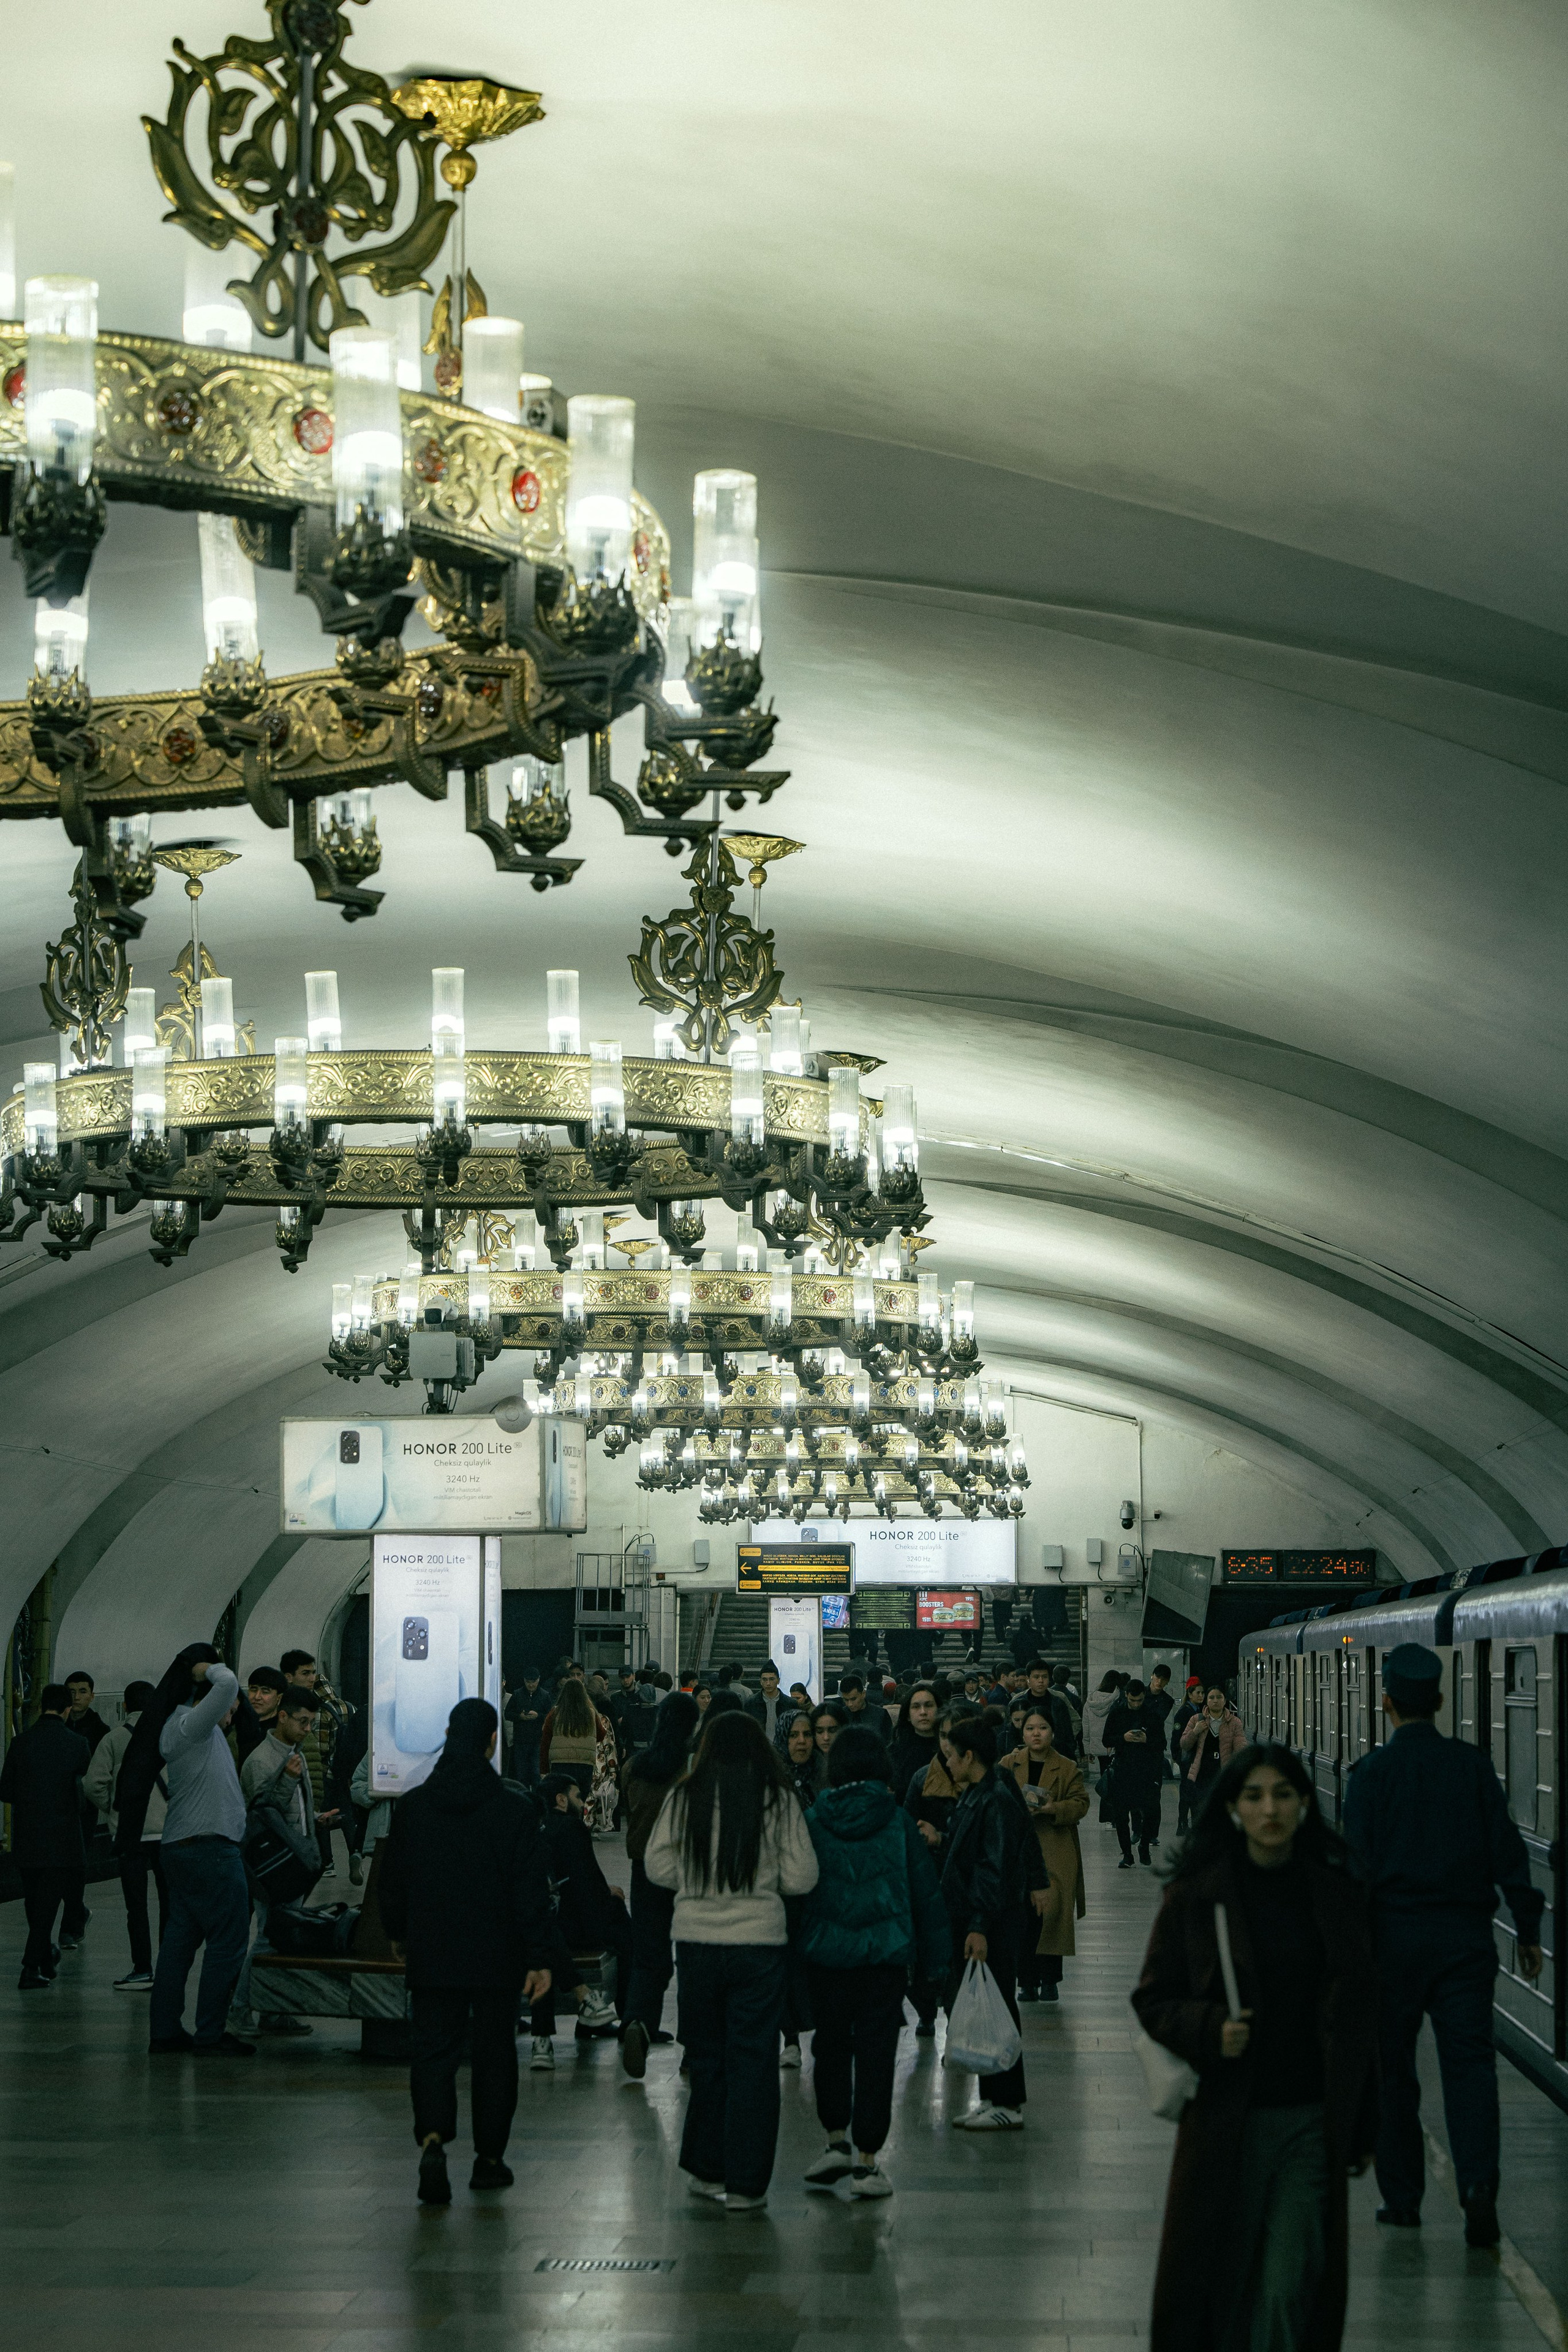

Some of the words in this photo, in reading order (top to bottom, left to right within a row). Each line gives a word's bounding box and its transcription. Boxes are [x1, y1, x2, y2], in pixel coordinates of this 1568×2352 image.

[403, 1443, 457, 1455] HONOR
[462, 1442, 483, 1454] 200
[488, 1442, 512, 1454] Lite
[464, 1458, 492, 1468] qulaylik
[870, 1531, 914, 1540] HONOR
[918, 1531, 936, 1540] 200
[939, 1531, 959, 1540] Lite
[383, 1555, 423, 1563] HONOR
[427, 1555, 444, 1564] 200
[447, 1555, 466, 1564] Lite
